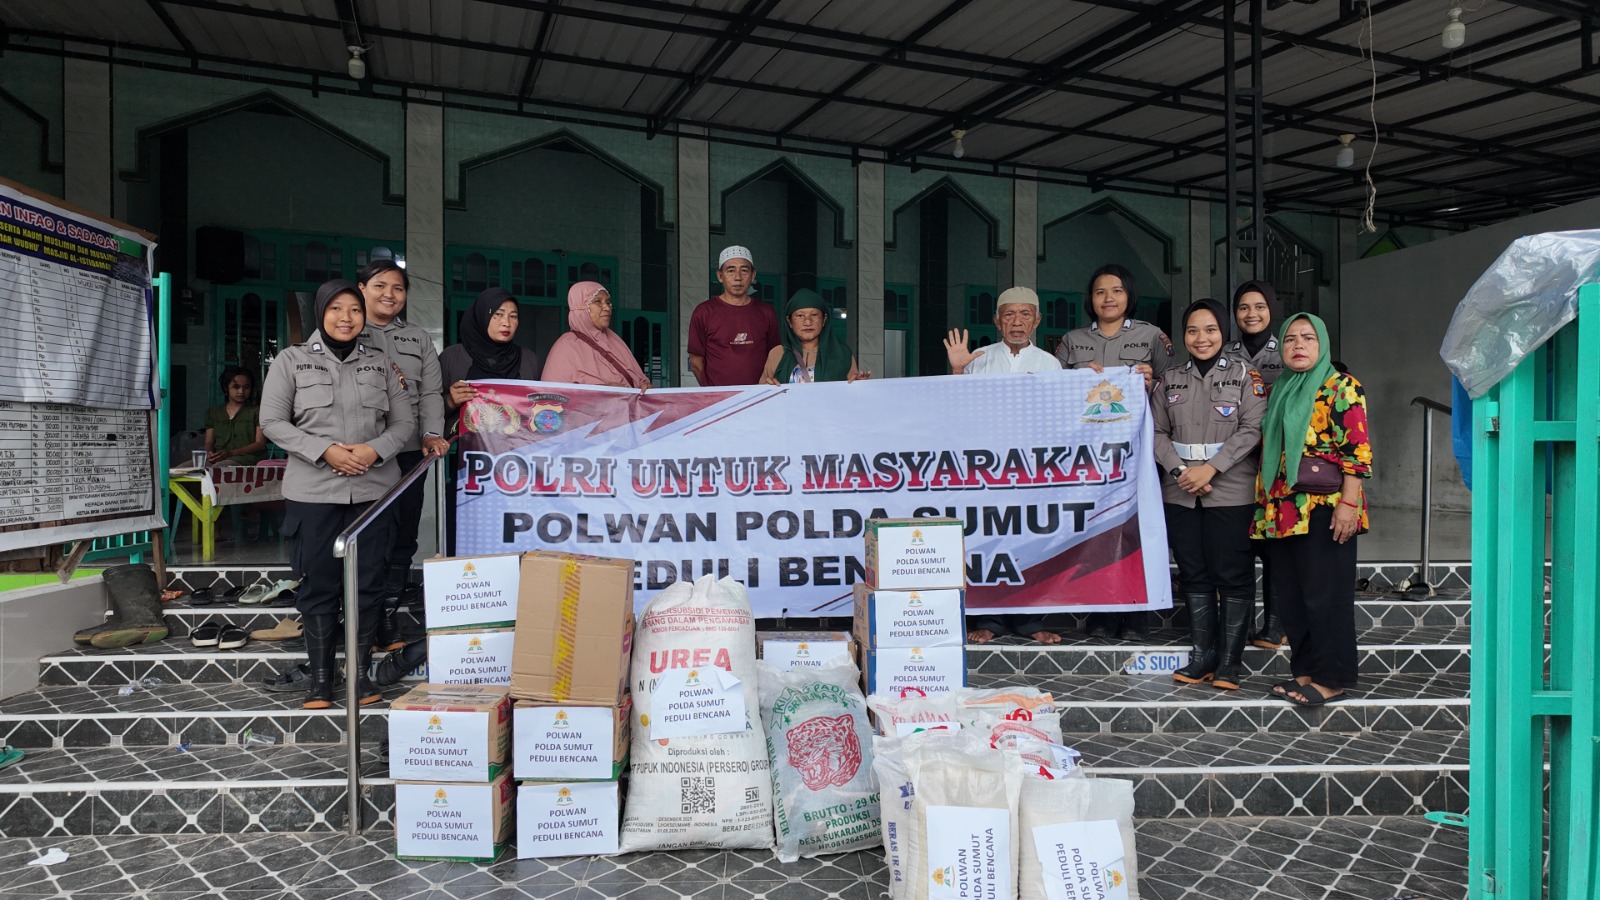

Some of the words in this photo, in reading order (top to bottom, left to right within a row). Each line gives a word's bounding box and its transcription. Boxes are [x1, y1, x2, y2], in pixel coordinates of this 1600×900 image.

[14, 206, 55, 231] INFAQ
[57, 221, 66, 235] &
[68, 224, 119, 251] SADAQAH
[23, 228, 42, 241] KAUM
[394, 336, 419, 344] POLRI
[356, 366, 385, 374] POLRI
[464, 452, 616, 497] POLRI
[628, 456, 792, 498] UNTUK
[802, 442, 1131, 493] MASYARAKAT
[503, 512, 717, 543] POLWAN
[634, 558, 759, 590] DULI
[779, 553, 1022, 588] BENNA
[456, 580, 491, 590] POLWAN
[445, 592, 471, 601] POLDA
[473, 590, 502, 600] SUMUT
[441, 603, 469, 613] PEDULI
[470, 600, 508, 610] BENCANA
[698, 617, 750, 625] PENGAWASAN
[890, 630, 914, 638] PEDULI
[461, 656, 496, 664] POLWAN
[650, 648, 732, 674] UREA
[1150, 656, 1180, 671] SUCI
[478, 666, 507, 674] SUMUT
[680, 688, 713, 698] POLWAN
[776, 685, 810, 711] KILAG
[814, 684, 844, 698] PADI
[669, 701, 694, 710] POLDA
[696, 699, 725, 708] SUMUT
[664, 714, 691, 723] PEDULI
[693, 710, 731, 720] BENCANA
[420, 736, 456, 744] POLWAN
[409, 747, 436, 756] POLDA
[438, 748, 468, 756] SUMUT
[535, 743, 562, 751] POLDA
[564, 743, 593, 751] SUMUT
[668, 748, 707, 757] Diproduksi
[710, 748, 725, 756] oleh
[404, 758, 433, 766] PEDULI
[435, 759, 473, 767] BENCANA
[637, 762, 659, 774] PUPUK
[661, 761, 704, 774] INDONESIA
[706, 760, 750, 775] (PERSERO)
[746, 790, 760, 801] SNI
[550, 808, 587, 817] POLWAN
[804, 804, 847, 822] BRUTTO
[856, 798, 867, 809] 29
[869, 793, 880, 804] KG
[427, 810, 462, 818] POLWAN
[825, 810, 870, 829] PRODUKSI
[416, 822, 443, 830] POLDA
[444, 822, 473, 830] SUMUT
[538, 821, 566, 830] POLDA
[568, 818, 598, 828] SUMUT
[412, 833, 439, 841] PEDULI
[441, 833, 479, 841] BENCANA
[533, 833, 562, 842] PEDULI
[564, 830, 603, 840] BENCANA
[799, 836, 821, 846] DESA
[824, 824, 870, 842] SUKARAMAI
[888, 822, 898, 852] BERAS
[971, 834, 982, 874] SUMUT
[985, 828, 995, 880] BENCANA
[892, 856, 900, 867] IR
[1056, 843, 1071, 880] PEDULI
[1071, 848, 1087, 884] POLDA
[958, 849, 968, 898] POLWAN
[1089, 862, 1105, 900] POLWA
